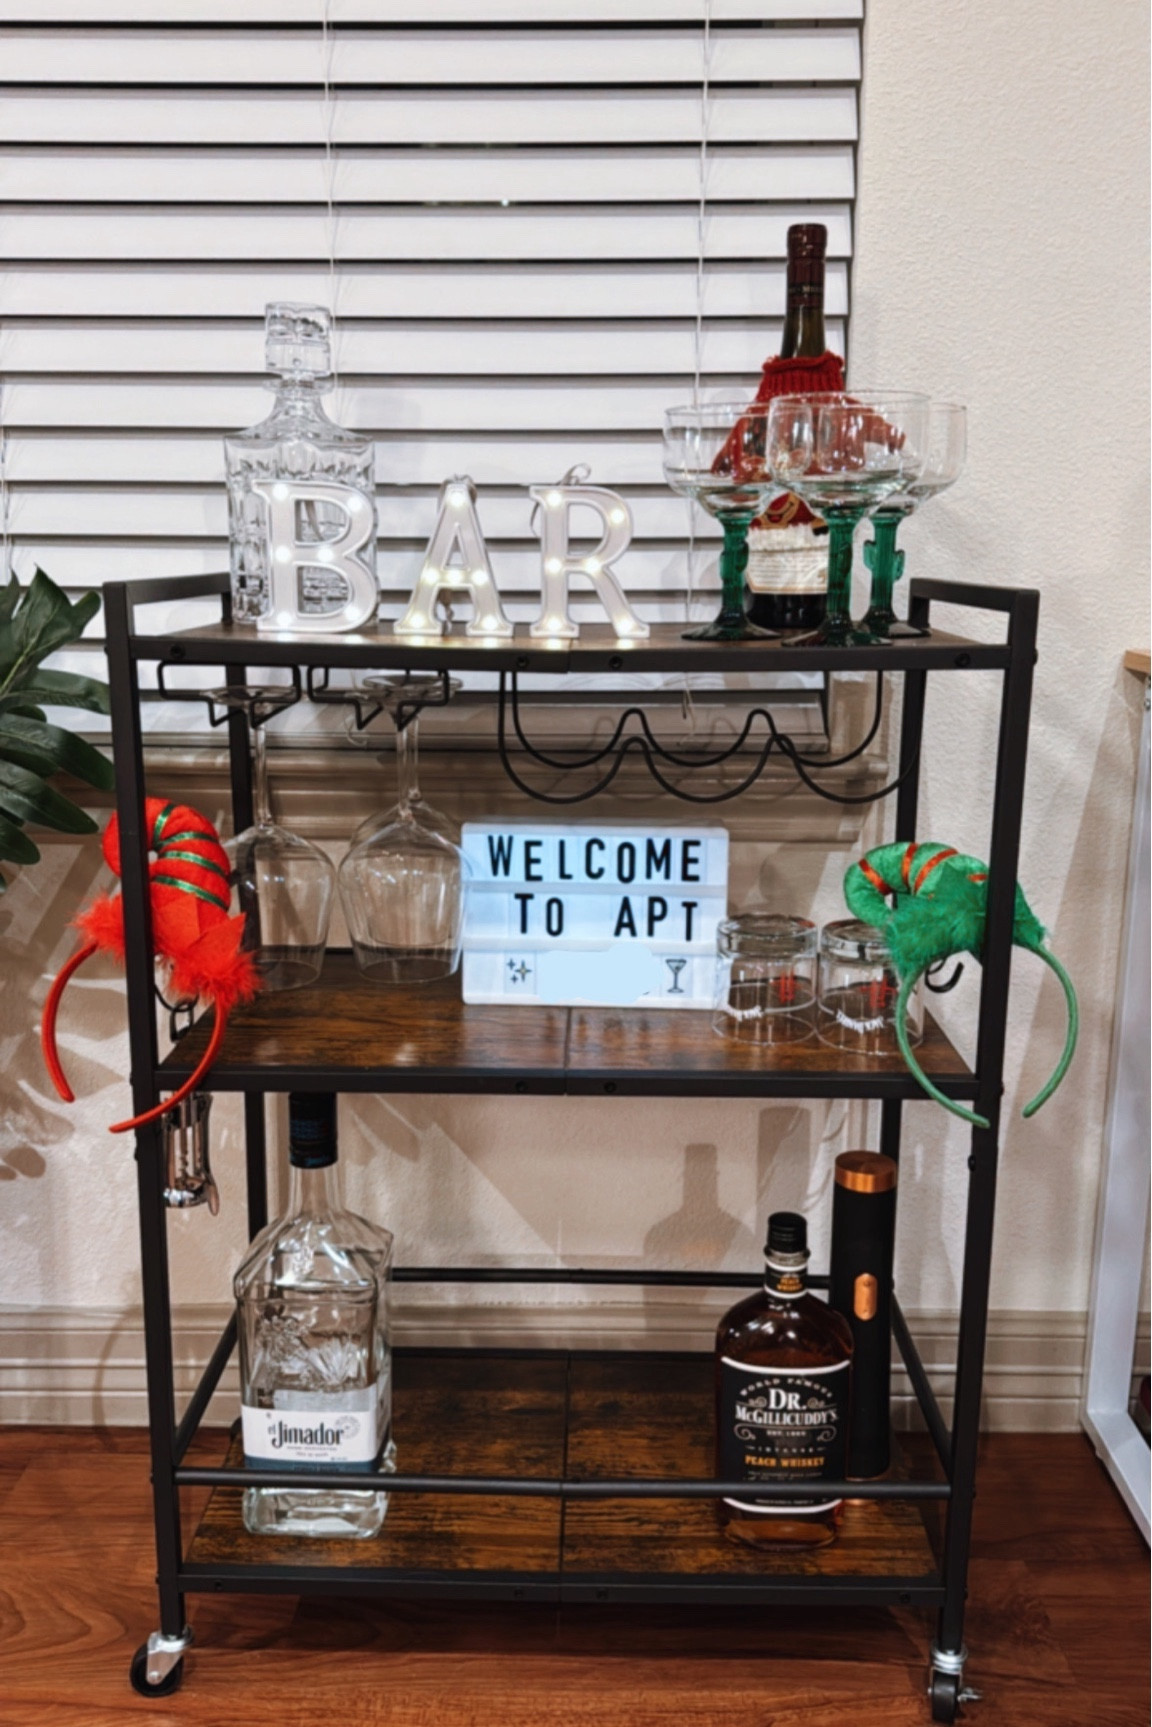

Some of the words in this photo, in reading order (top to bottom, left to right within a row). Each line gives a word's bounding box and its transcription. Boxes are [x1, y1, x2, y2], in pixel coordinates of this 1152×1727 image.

[252, 479, 650, 637] BAR
[488, 835, 702, 883] WELCOME
[514, 893, 564, 937] TO
[614, 896, 698, 941] APT
[271, 1420, 345, 1449] Jimador
[744, 1455, 777, 1467] PEACH
[780, 1456, 825, 1468] WHISKEY
